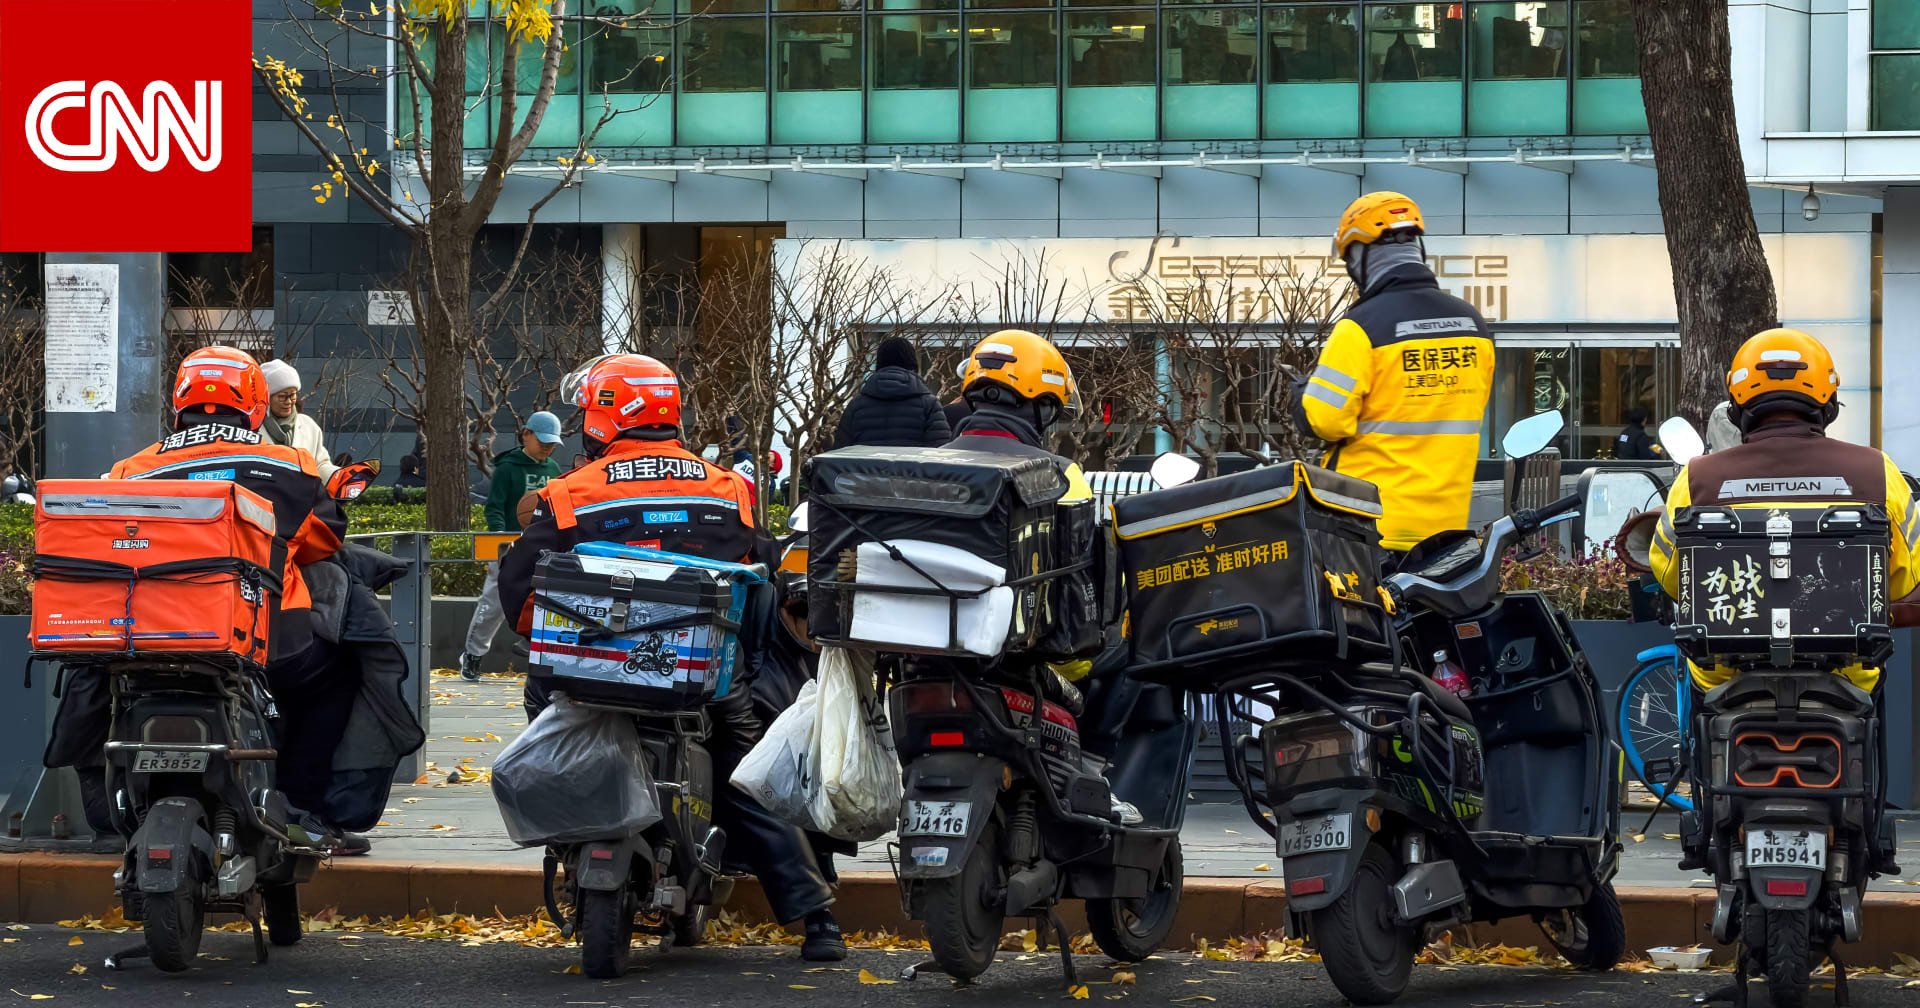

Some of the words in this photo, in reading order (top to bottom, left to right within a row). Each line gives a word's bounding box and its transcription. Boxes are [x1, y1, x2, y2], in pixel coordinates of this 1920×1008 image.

[1413, 321, 1462, 330] MEITUAN
[1402, 345, 1477, 372] 医保买药
[161, 422, 261, 452] 淘宝闪购
[608, 457, 706, 482] 淘宝闪购
[1745, 481, 1822, 493] MEITUAN
[1136, 556, 1211, 591] 美团配送
[1215, 540, 1289, 573] 准时好用
[1680, 553, 1691, 619] 直面天命
[1872, 552, 1884, 619] 直面天命
[139, 760, 201, 769] ER3852
[902, 817, 963, 833] PJ4116
[1285, 831, 1345, 853] V45900
[1751, 847, 1820, 865] PN5941
